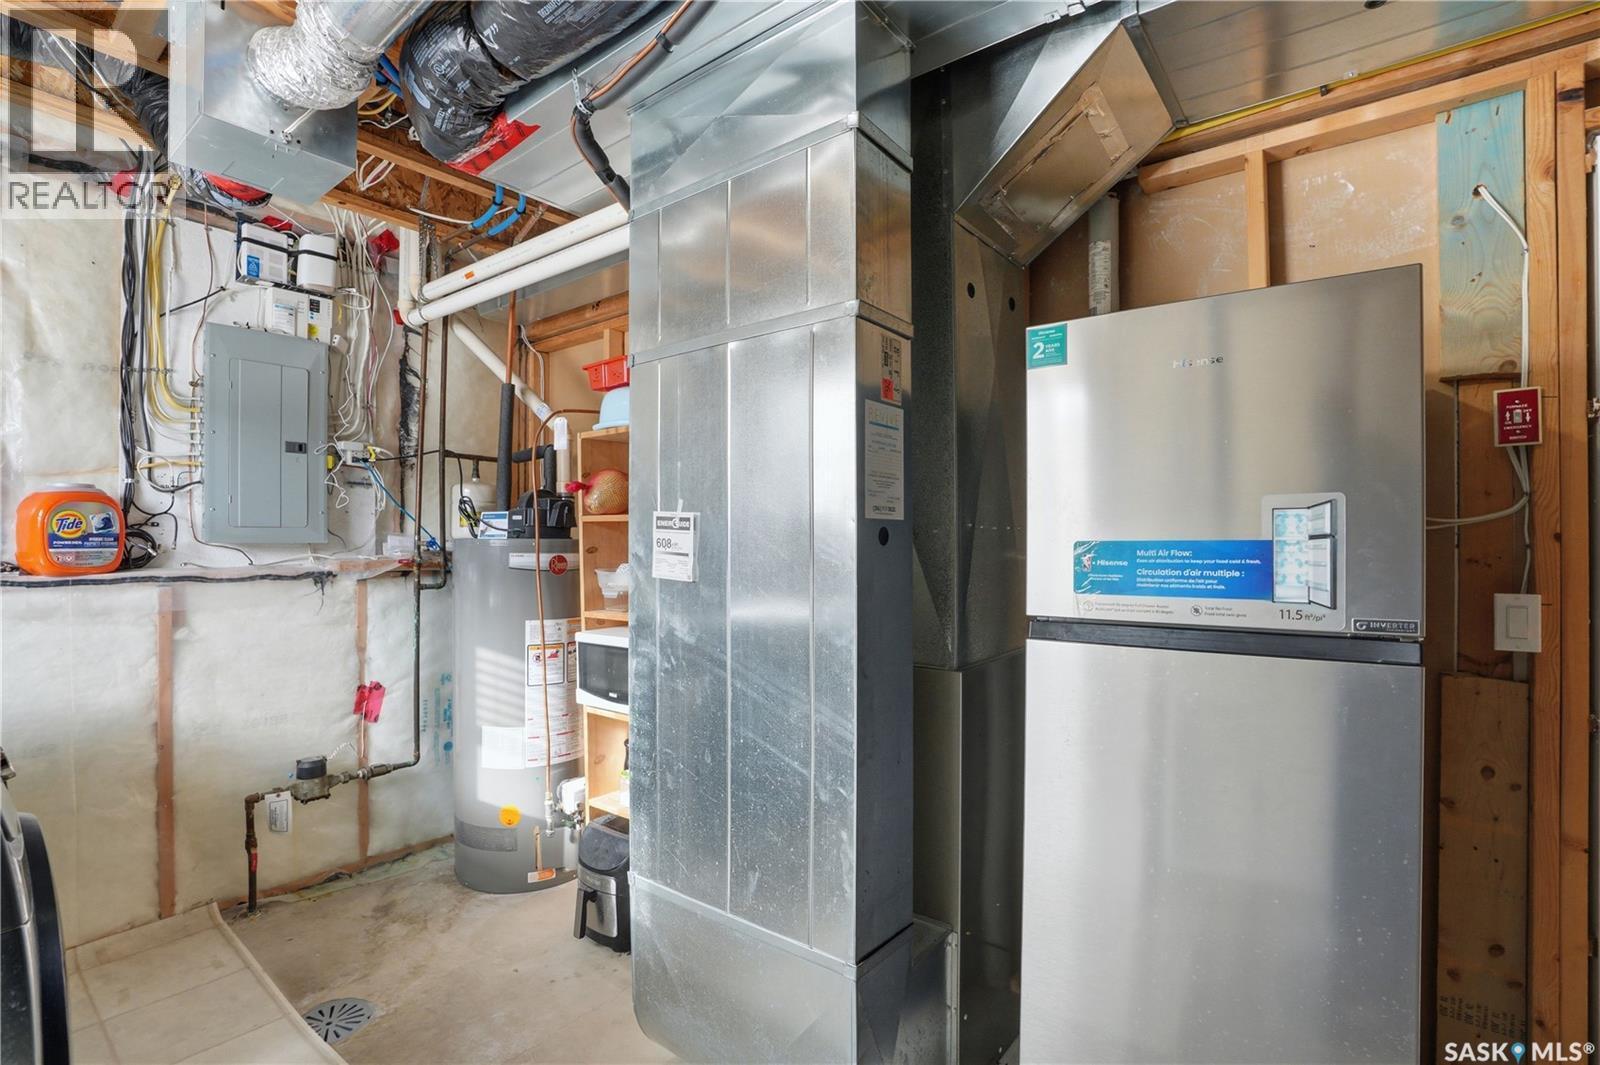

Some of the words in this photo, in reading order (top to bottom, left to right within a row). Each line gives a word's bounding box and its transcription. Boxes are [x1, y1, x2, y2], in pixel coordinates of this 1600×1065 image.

[1032, 342, 1045, 359] 2
[56, 517, 83, 532] Tide
[656, 537, 672, 549] 608
[1136, 549, 1157, 557] Multi
[1158, 549, 1169, 557] Air
[1170, 549, 1193, 557] Flow:
[1097, 559, 1129, 567] Hisense
[1136, 568, 1182, 577] Circulation
[1183, 568, 1202, 577] d'air
[1203, 569, 1241, 578] multiple
[1280, 609, 1303, 621] 11.5
[1369, 621, 1416, 630] INVERTER
